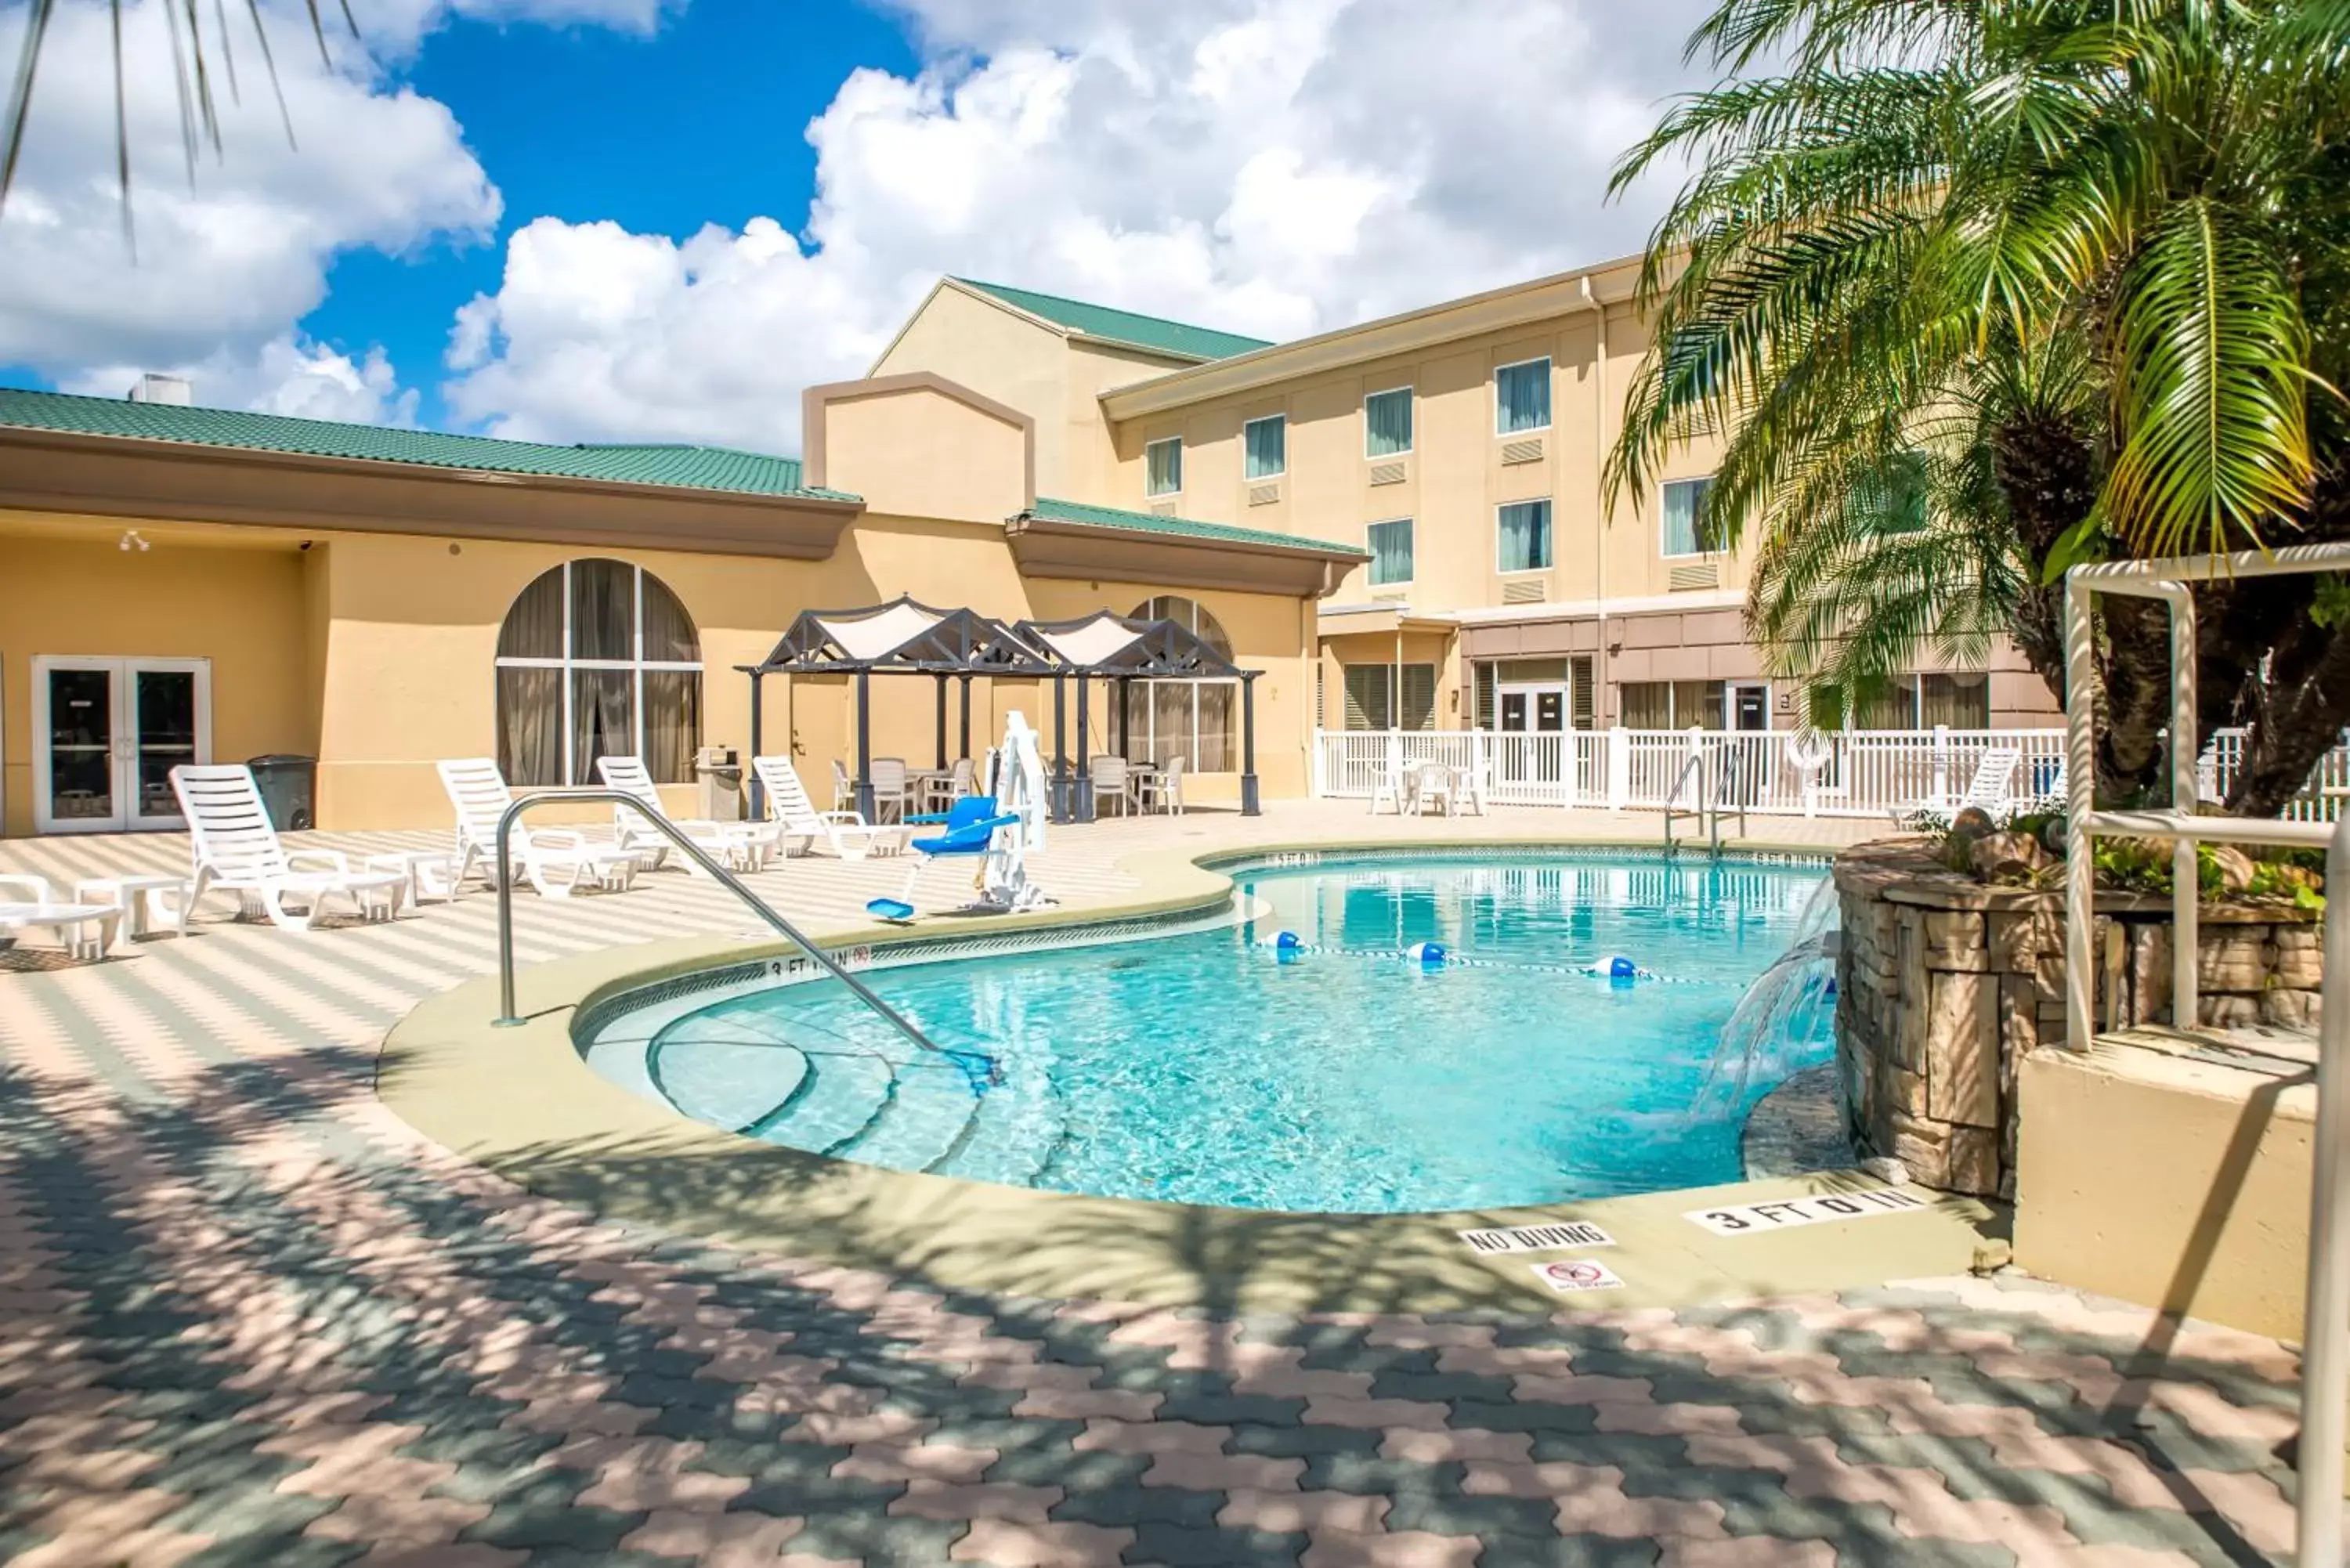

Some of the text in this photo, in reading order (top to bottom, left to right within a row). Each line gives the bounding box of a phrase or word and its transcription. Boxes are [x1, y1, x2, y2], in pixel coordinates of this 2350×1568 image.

[789, 958, 806, 973] FT
[1706, 1190, 1925, 1229] 3 FT 0 IN
[1466, 1224, 1607, 1251] NO DIVING
